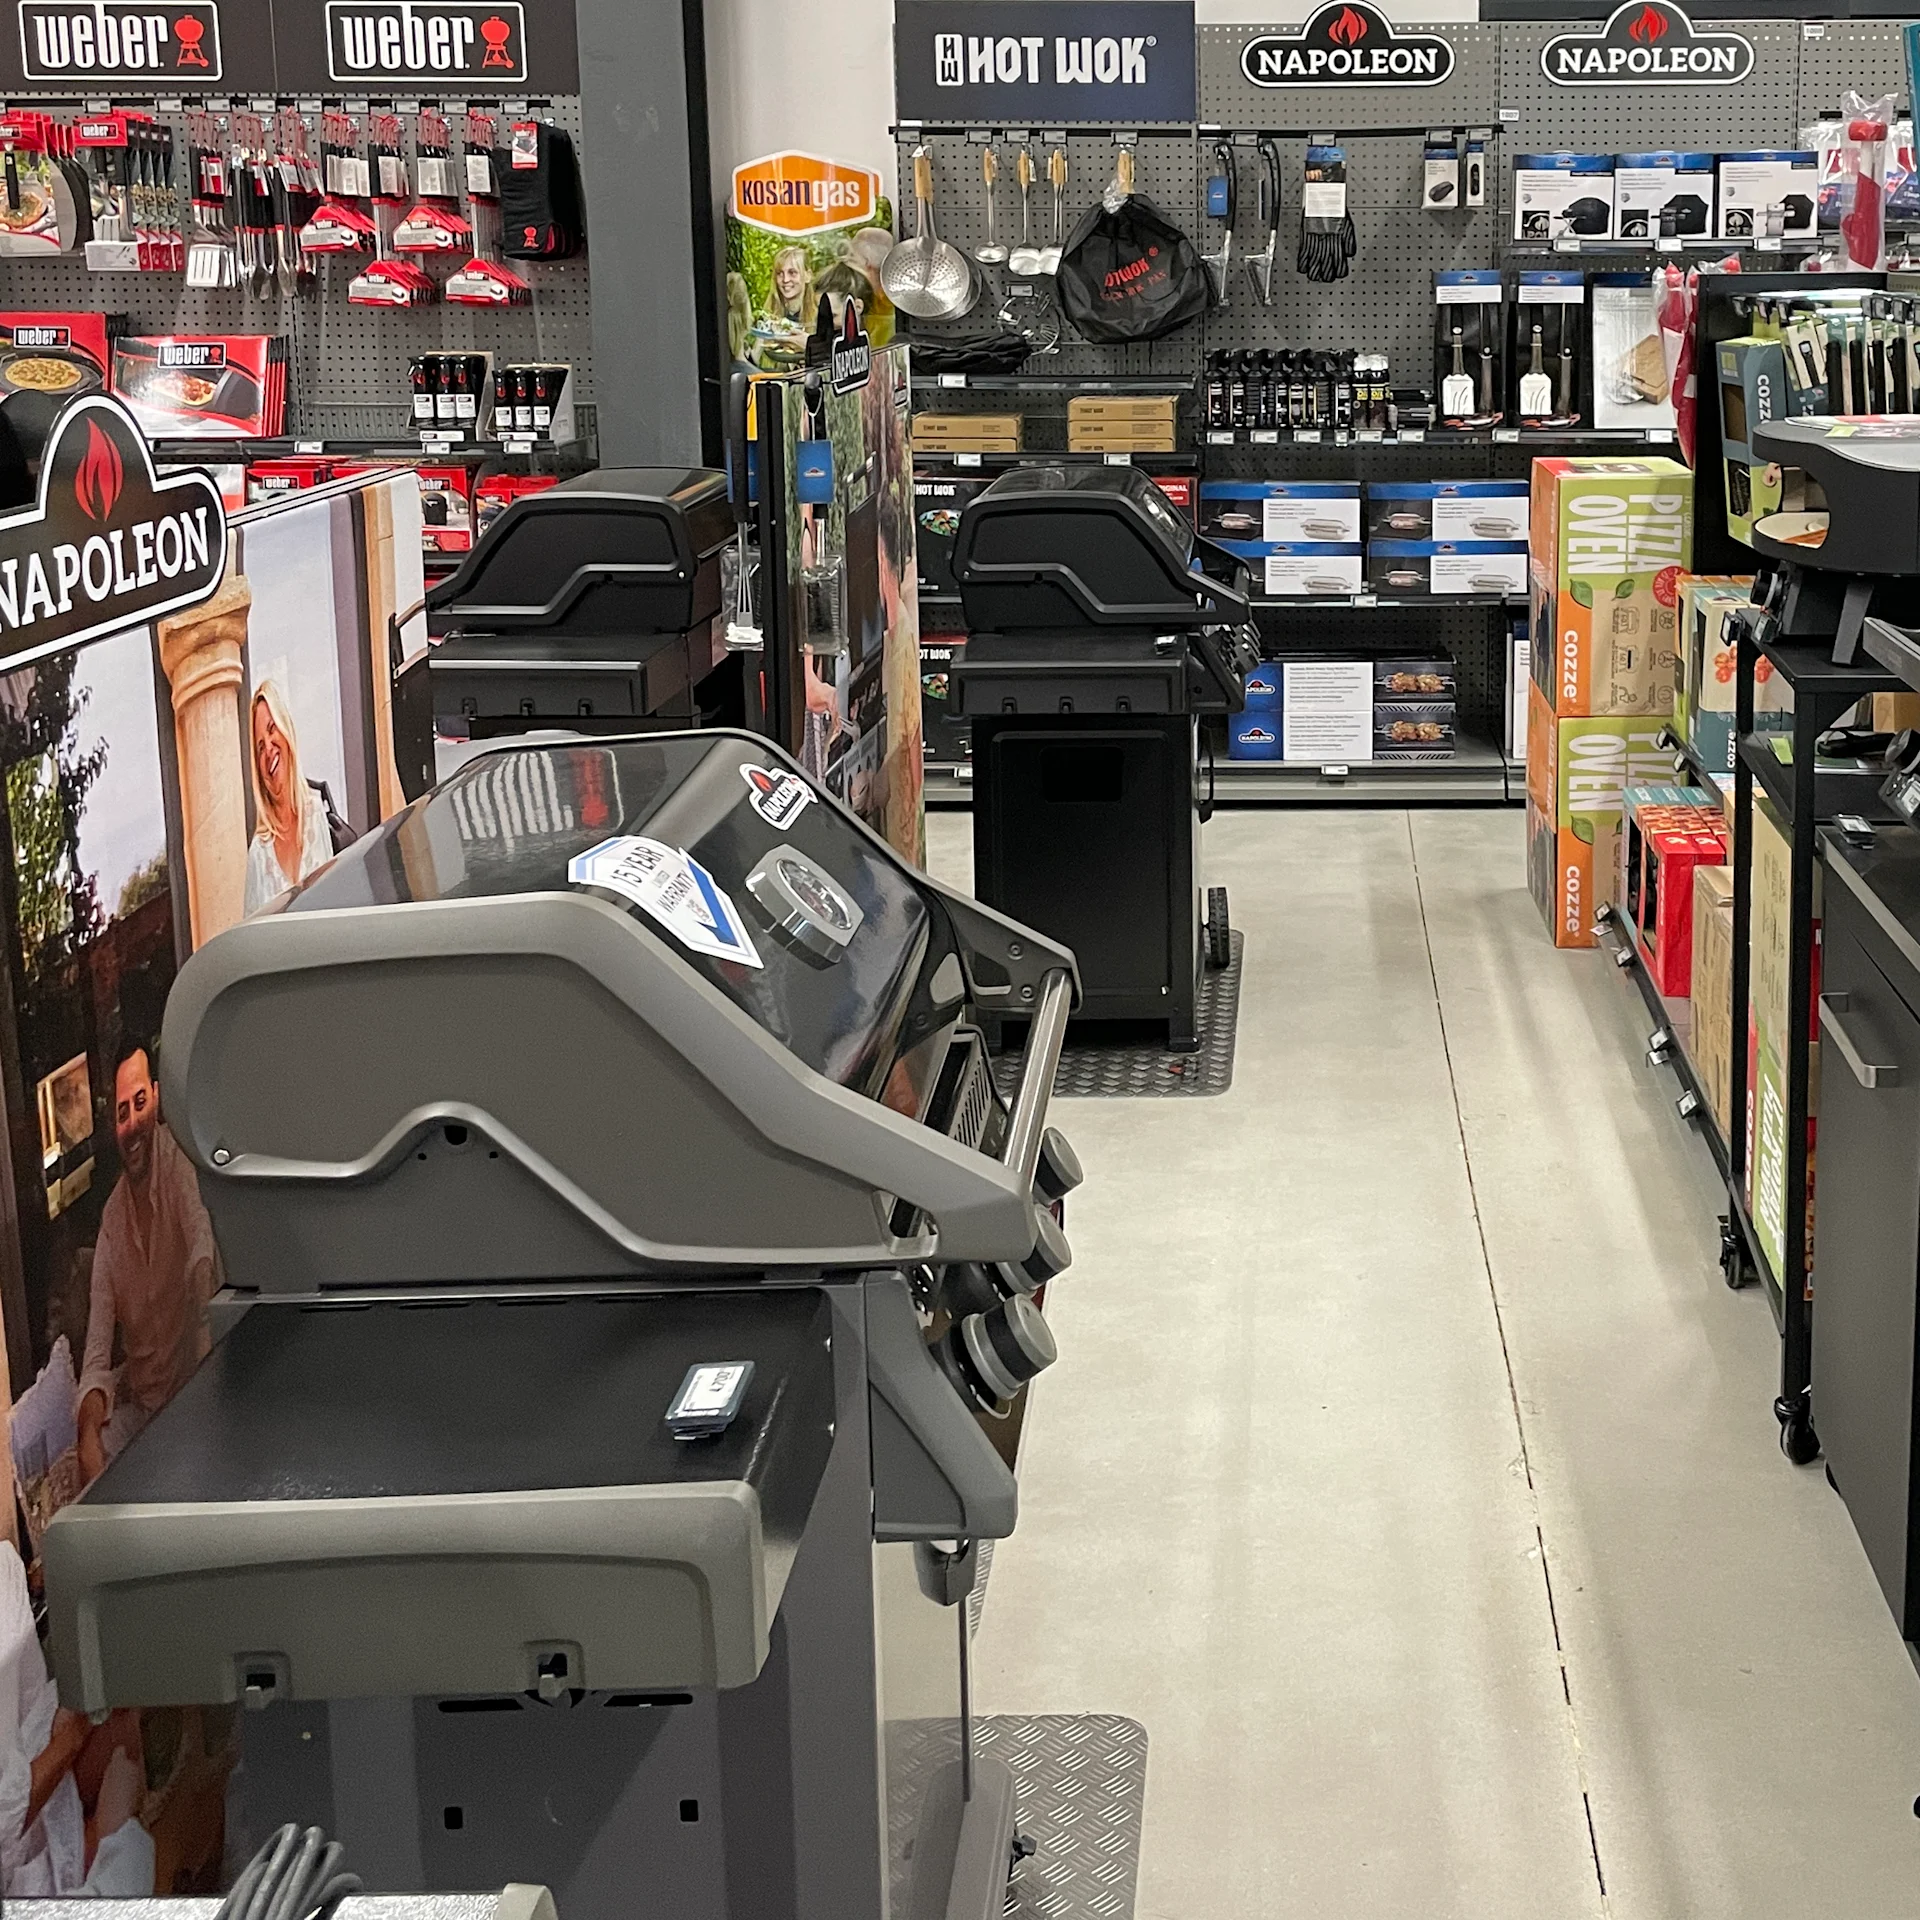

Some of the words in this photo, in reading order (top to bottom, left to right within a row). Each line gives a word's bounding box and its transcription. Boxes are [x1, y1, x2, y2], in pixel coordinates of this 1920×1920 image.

[33, 14, 168, 68] weber
[340, 15, 474, 69] weber
[968, 36, 1044, 84] HOT
[1257, 48, 1437, 75] NAPOLEON
[1557, 47, 1738, 73] NAPOLEON
[83, 124, 109, 137] weber
[17, 328, 57, 346] weber
[163, 345, 210, 365] weber
[265, 476, 291, 488] weber
[916, 484, 933, 496] HOT
[1567, 494, 1629, 575] OVEN
[1628, 494, 1683, 574] PIZZA
[0, 507, 209, 634] NAPOLEON
[1563, 630, 1579, 699] cozze
[1568, 734, 1627, 811] OVEN
[610, 869, 643, 888] 15
[619, 845, 665, 875] YEAR
[656, 869, 696, 914] WARRANTY
[1566, 865, 1580, 932] cozze
